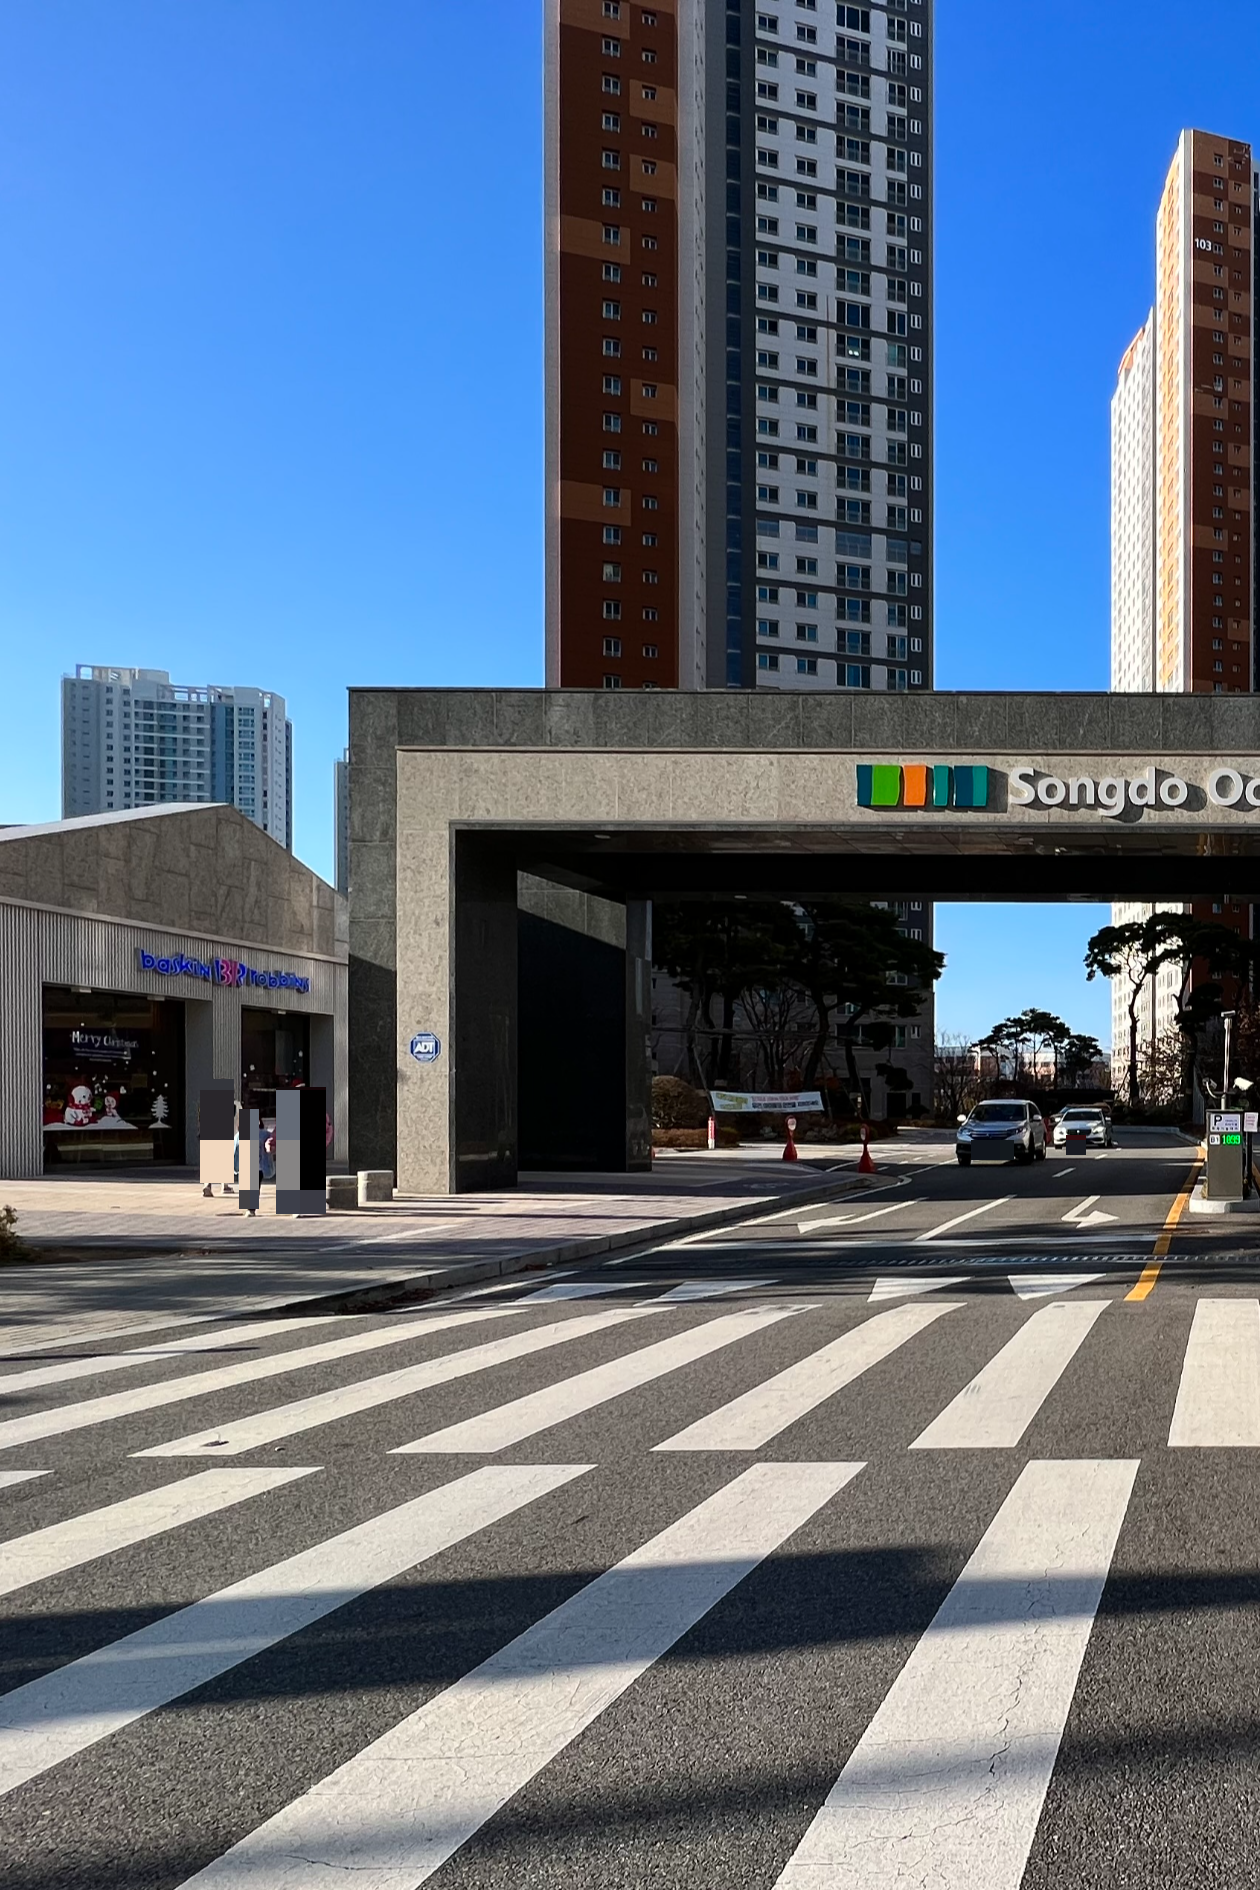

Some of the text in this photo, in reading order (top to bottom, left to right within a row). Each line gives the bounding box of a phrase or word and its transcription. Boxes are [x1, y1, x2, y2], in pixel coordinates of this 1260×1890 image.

[1194, 237, 1212, 251] 103
[1008, 766, 1188, 817] Songdo
[140, 949, 211, 980] baskin
[249, 968, 311, 993] robbins
[72, 1030, 101, 1047] Merry
[414, 1041, 435, 1053] ADT
[1214, 1114, 1222, 1126] P
